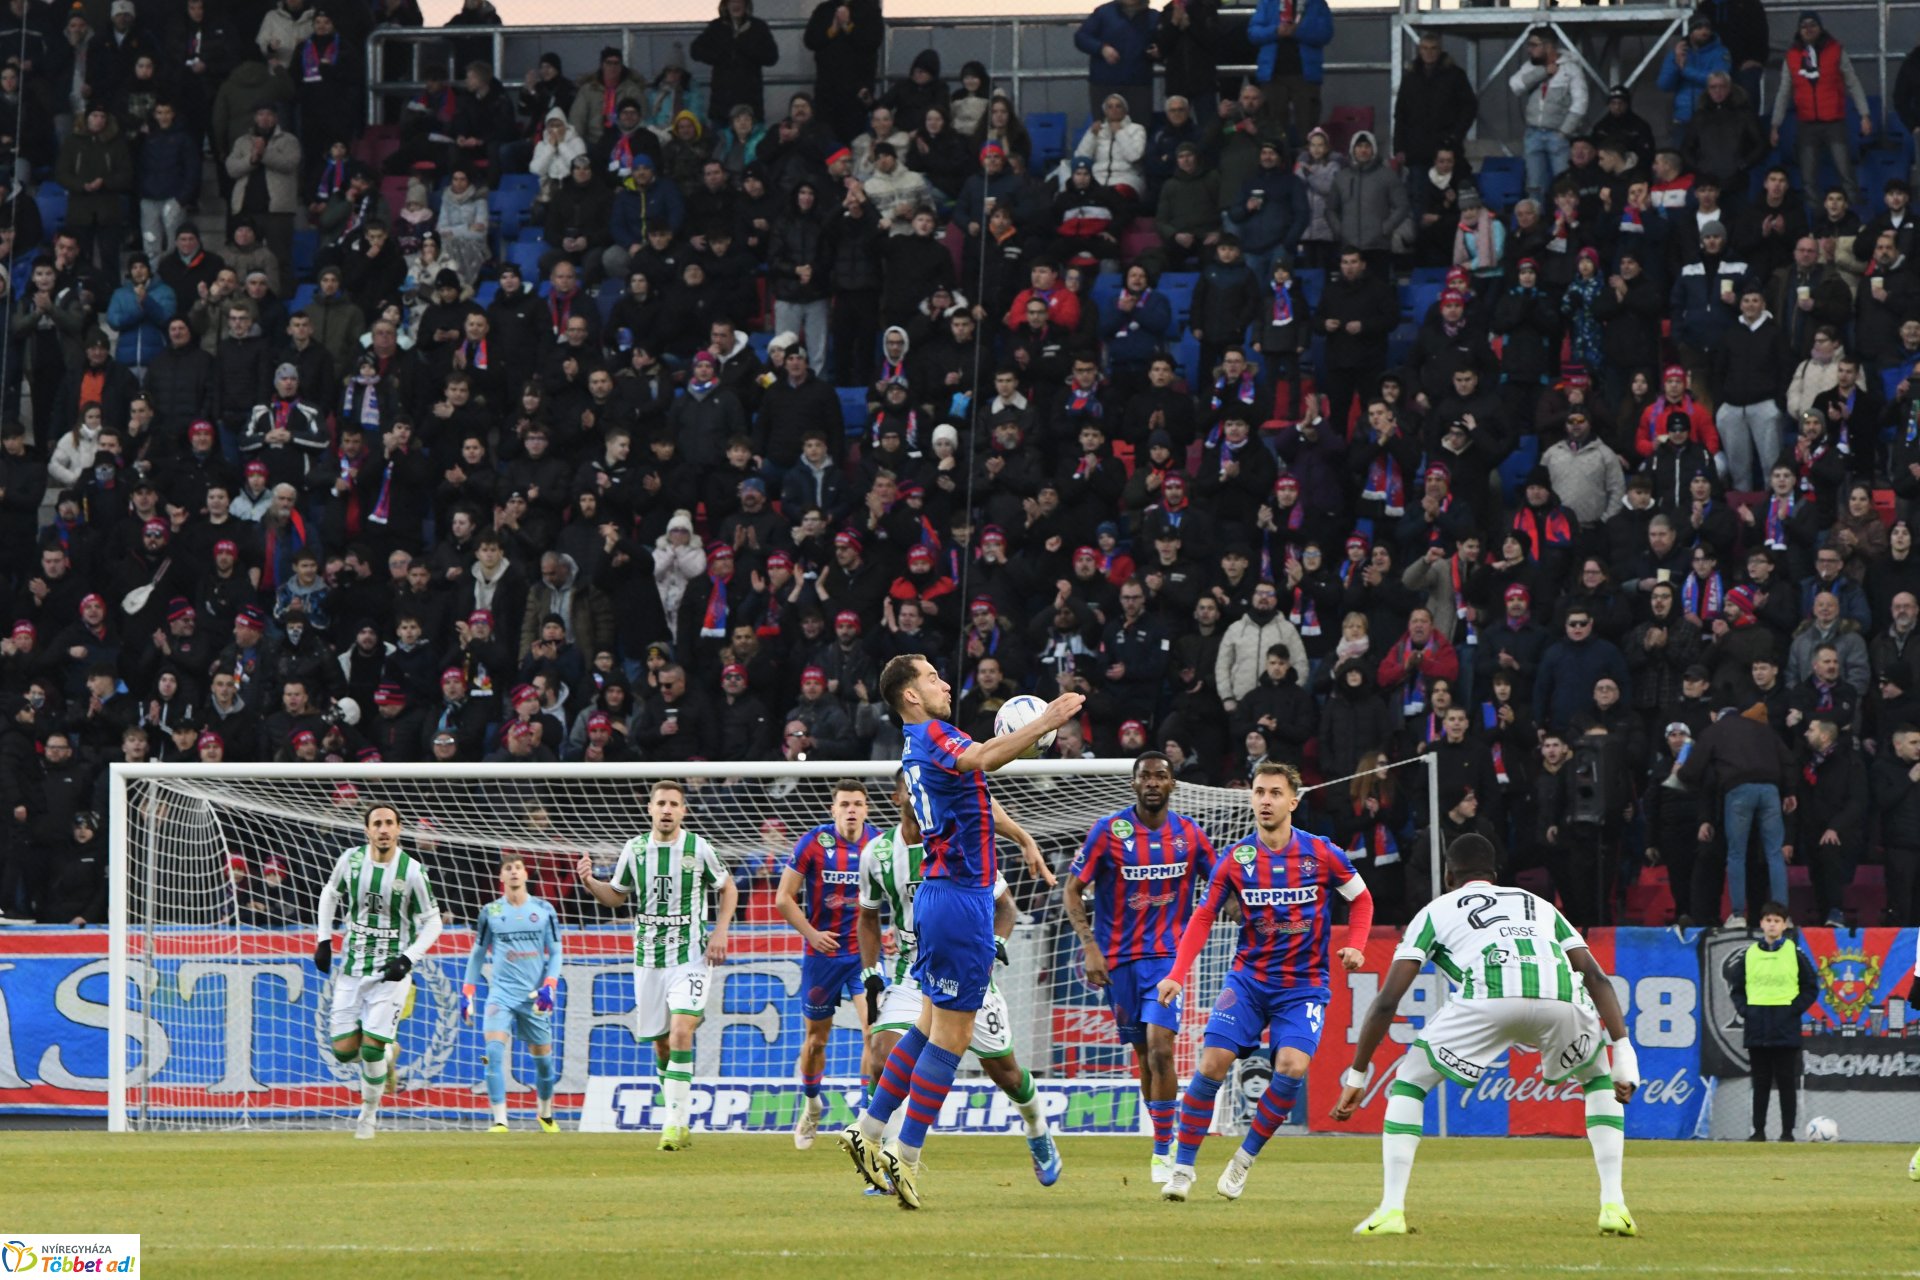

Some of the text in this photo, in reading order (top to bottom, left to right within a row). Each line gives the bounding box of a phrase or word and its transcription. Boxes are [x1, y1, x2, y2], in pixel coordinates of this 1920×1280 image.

[1457, 891, 1537, 930] 27
[1499, 926, 1538, 938] CISSE
[689, 979, 704, 997] 19
[1305, 1002, 1322, 1023] 14
